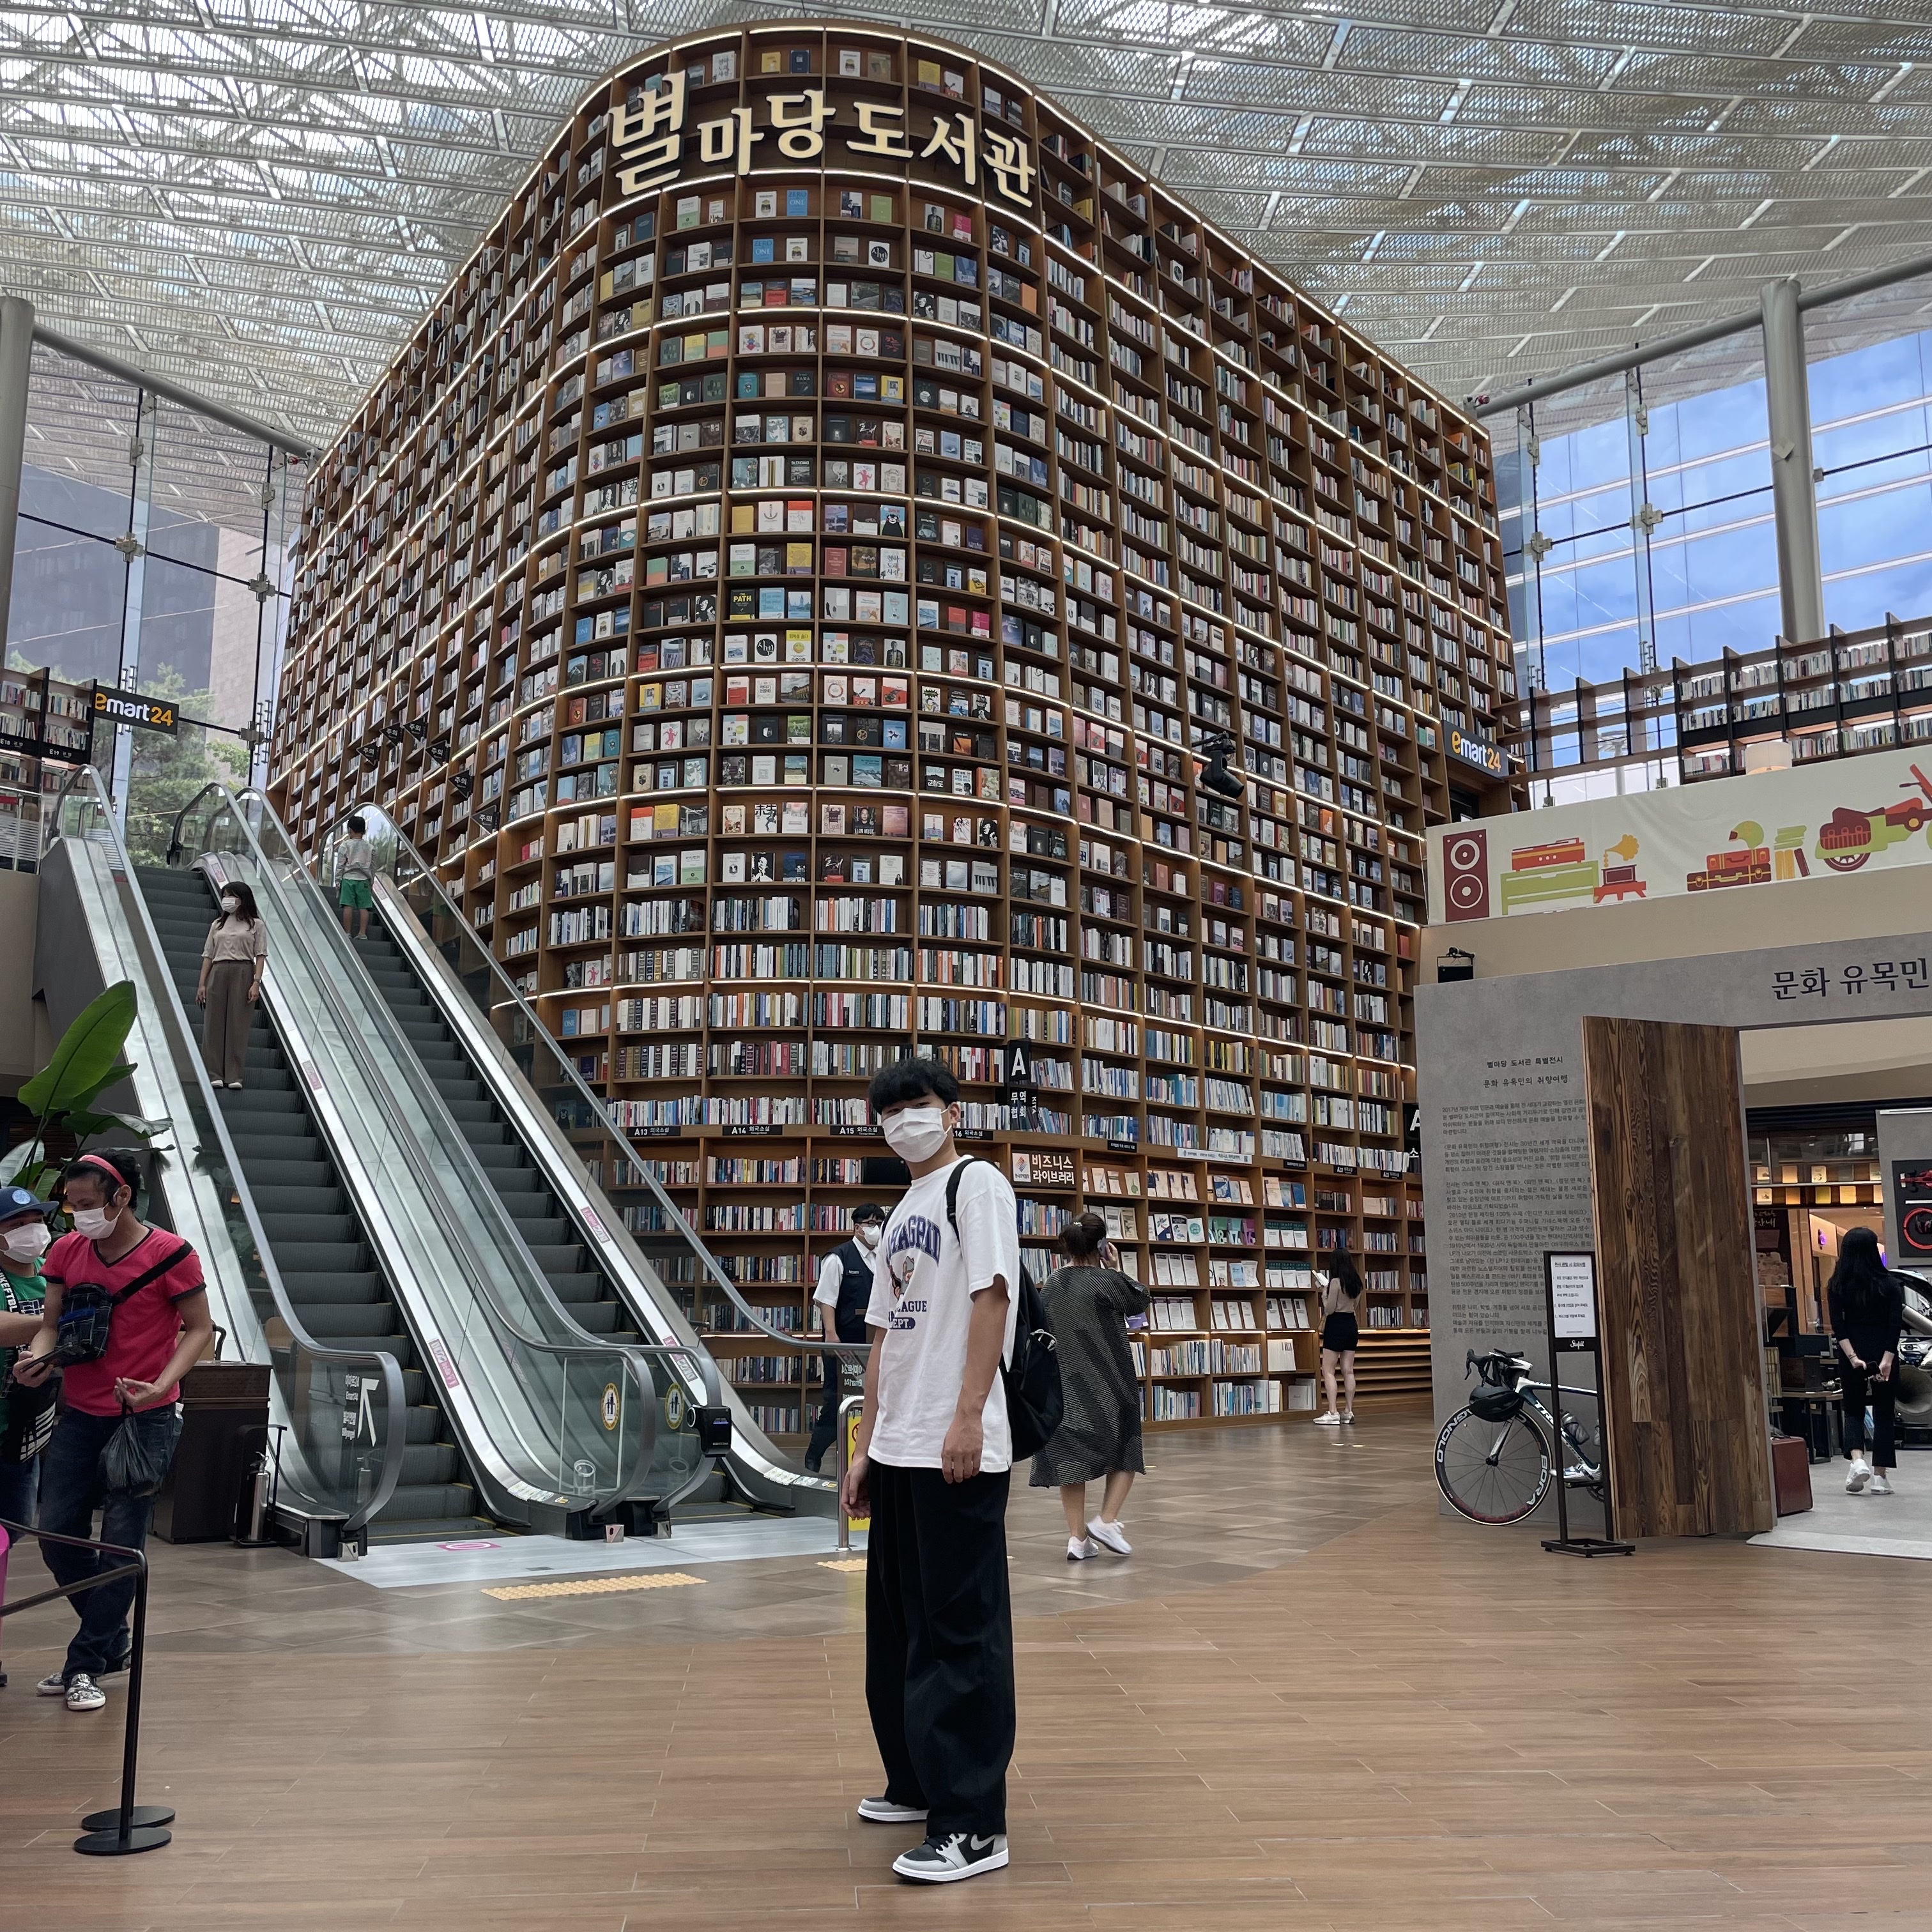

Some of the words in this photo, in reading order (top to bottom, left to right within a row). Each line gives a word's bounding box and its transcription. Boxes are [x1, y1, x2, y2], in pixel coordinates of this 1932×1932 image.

[609, 70, 836, 195] 별마당
[847, 101, 1036, 208] 도서관
[95, 692, 174, 727] emart24
[1452, 730, 1501, 773] emart24
[1771, 967, 1830, 1000] 문화
[1840, 957, 1930, 997] 유목민
[1011, 1048, 1026, 1077] A
[1535, 1056, 1563, 1064] 특별전시
[1483, 1079, 1498, 1088] 문화
[1503, 1077, 1533, 1086] 유목민의
[1537, 1075, 1568, 1084] 취향여행
[731, 1126, 746, 1135] A14
[839, 1126, 855, 1135] A15
[1409, 1109, 1421, 1131] A
[1032, 1154, 1073, 1170] 비즈니스
[1033, 1170, 1075, 1184] 라이브러리
[1526, 1453, 1547, 1505] BORA
